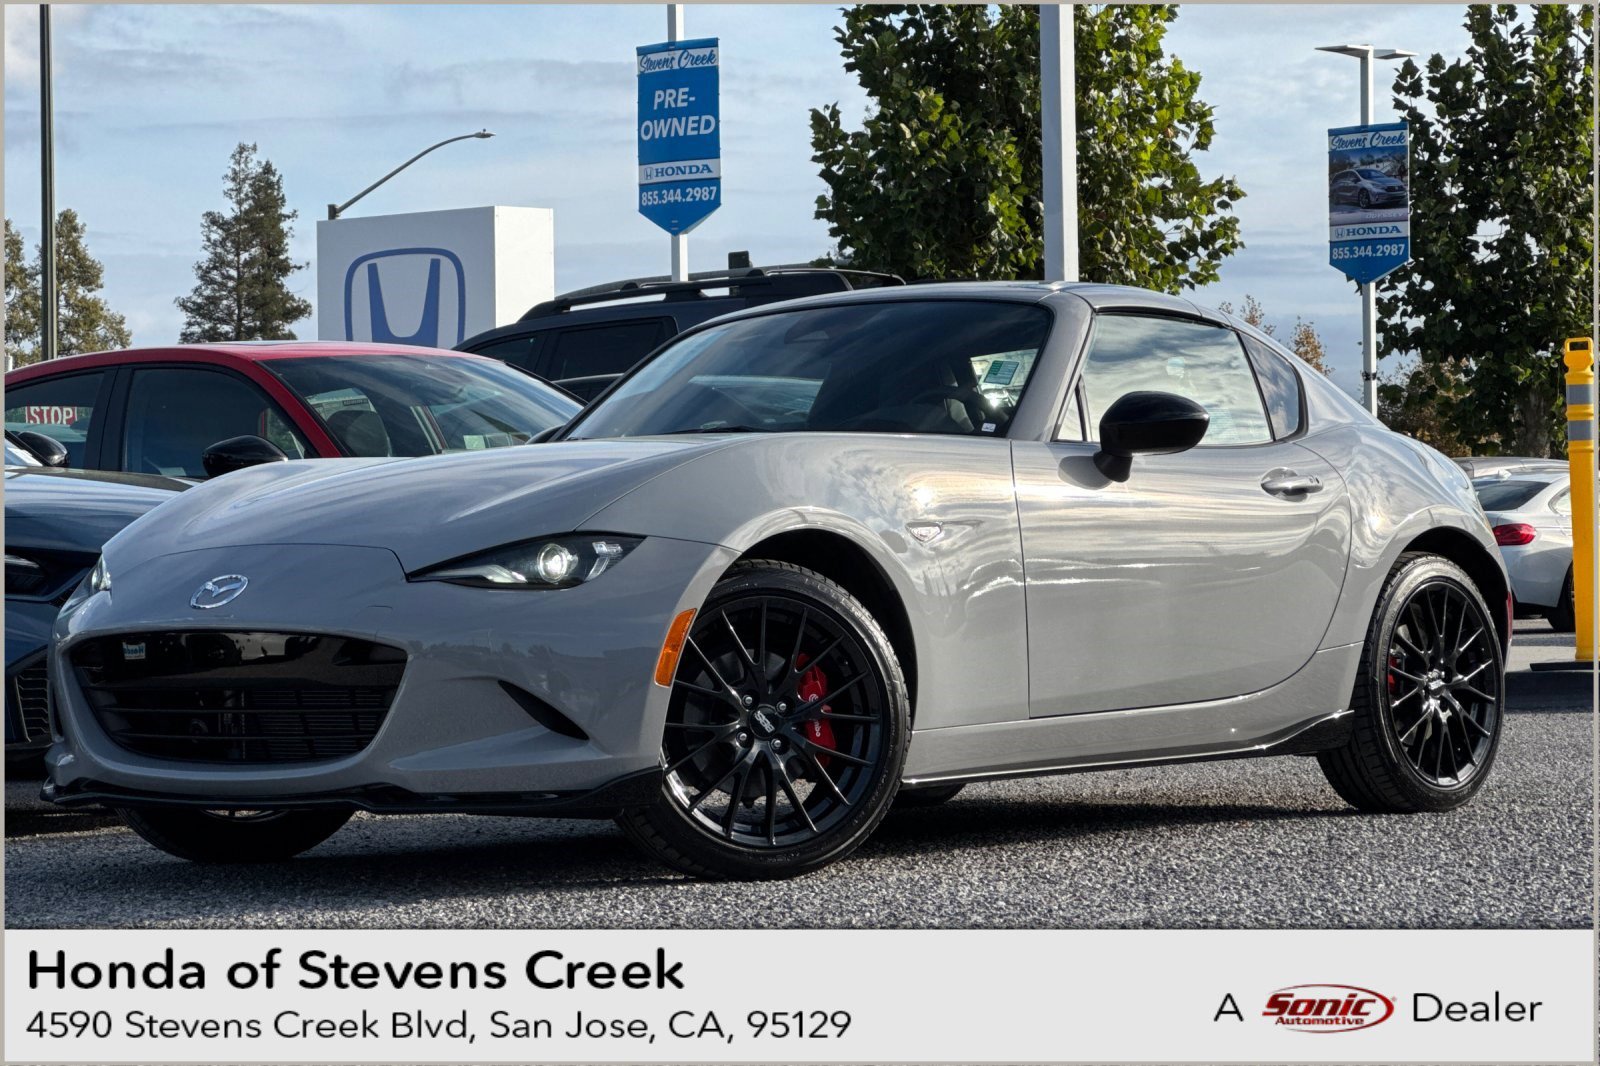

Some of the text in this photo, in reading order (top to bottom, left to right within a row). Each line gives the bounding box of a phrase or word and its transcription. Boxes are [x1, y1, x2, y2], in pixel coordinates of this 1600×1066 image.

[640, 49, 717, 73] Stevens Creek
[653, 87, 696, 110] PRE-
[641, 115, 716, 140] OWNED
[1331, 131, 1405, 150] Stevens Creek
[655, 164, 713, 178] HONDA
[641, 186, 717, 206] 855.344.2987
[1346, 226, 1402, 237] HONDA
[1332, 243, 1405, 260] 855.344.2987
[30, 406, 73, 424] STOP
